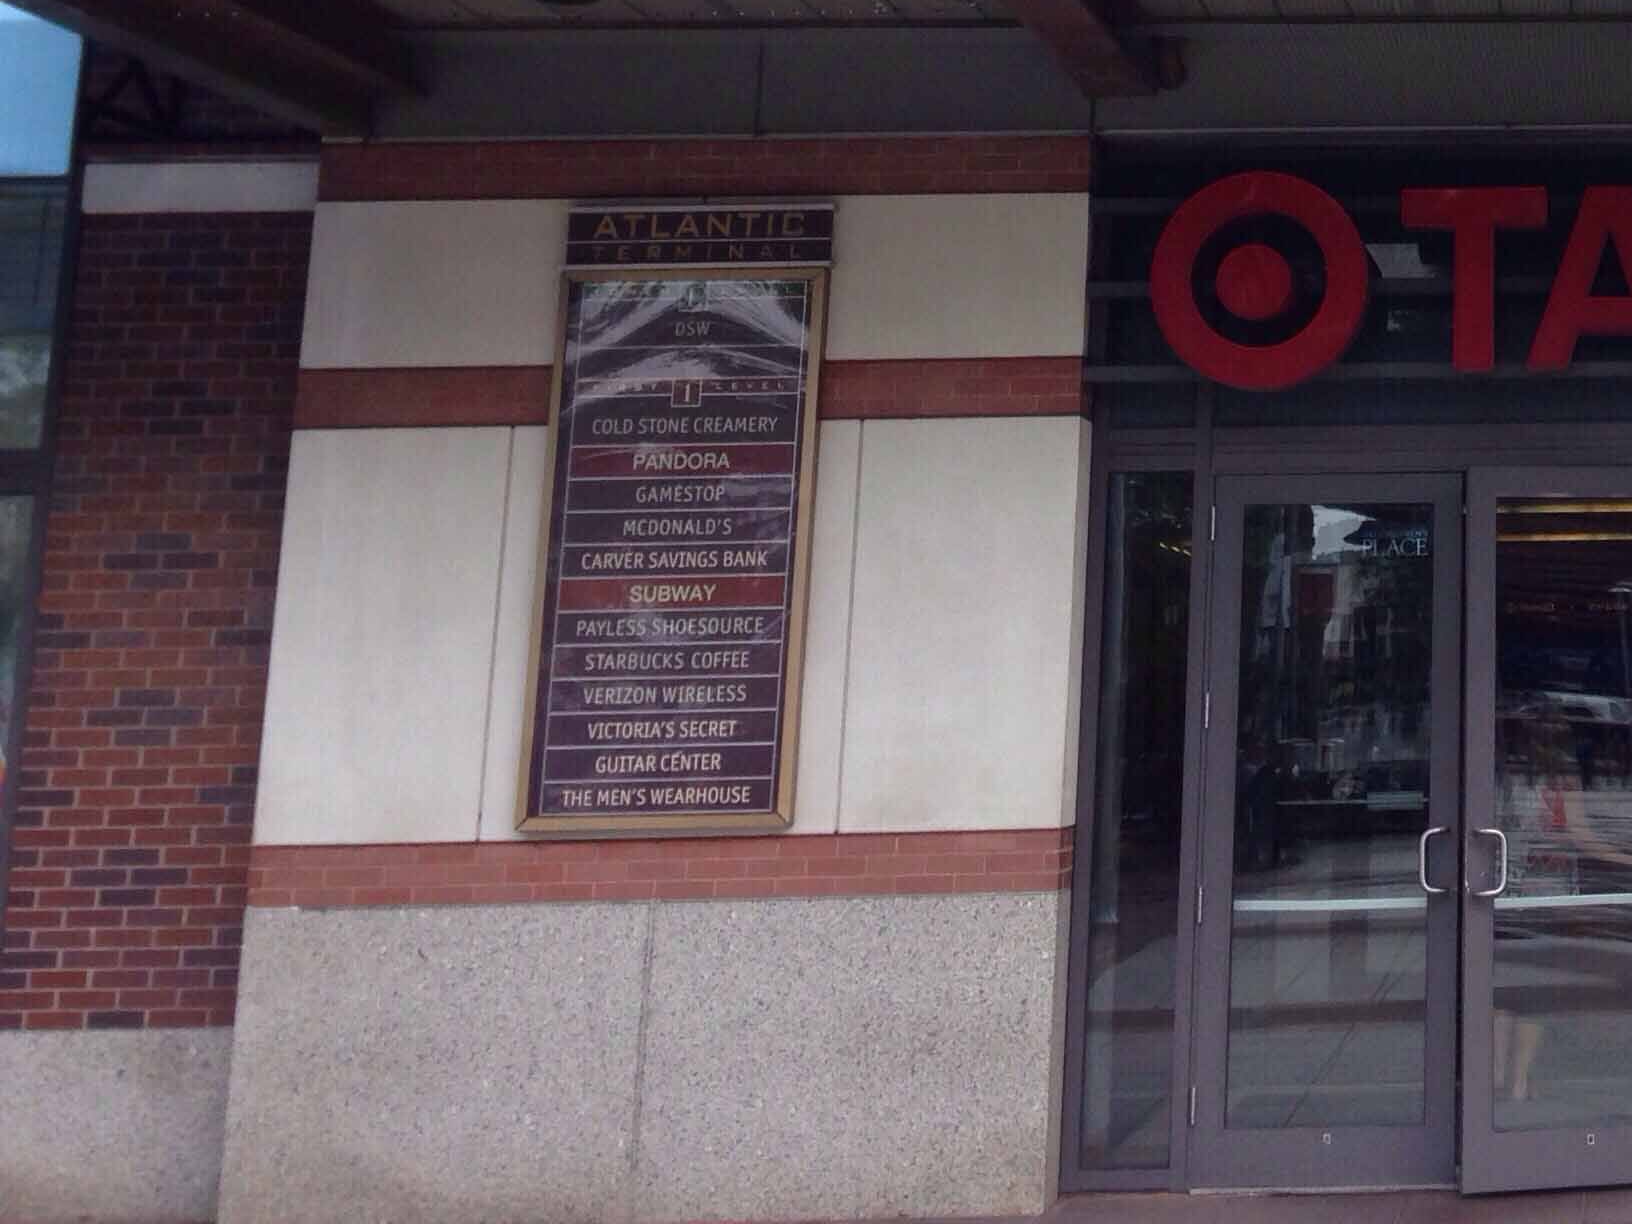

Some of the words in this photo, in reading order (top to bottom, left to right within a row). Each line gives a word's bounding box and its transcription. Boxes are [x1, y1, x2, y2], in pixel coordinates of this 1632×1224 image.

[594, 213, 806, 239] ATLANTIC
[592, 244, 801, 262] TERMINAL
[675, 321, 712, 337] DSW
[592, 417, 633, 436] COLD
[637, 417, 688, 434] STONE
[694, 416, 778, 434] CREAMERY
[633, 453, 730, 470] PANDORA
[636, 485, 726, 504] GAMESTOP
[623, 518, 732, 537] MCDONALD'S
[581, 552, 644, 570] CARVER
[649, 551, 718, 569] SAVINGS
[723, 550, 768, 567] BANK
[630, 584, 716, 603] SUBWAY
[576, 619, 647, 637] PAYLESS
[650, 616, 764, 636] SHOESOURCE
[585, 653, 684, 671] STARBUCKS
[691, 651, 749, 669] COFFEE
[583, 686, 656, 704] VERIZON
[662, 684, 747, 703] WIRELESS
[588, 722, 674, 740] VICTORIA'S
[679, 720, 737, 738] SECRET
[595, 755, 656, 774] GUITAR
[661, 754, 721, 772] CENTER
[562, 789, 592, 807] THE
[597, 788, 646, 806] MEN'S
[650, 786, 751, 805] WEARHOUSE
